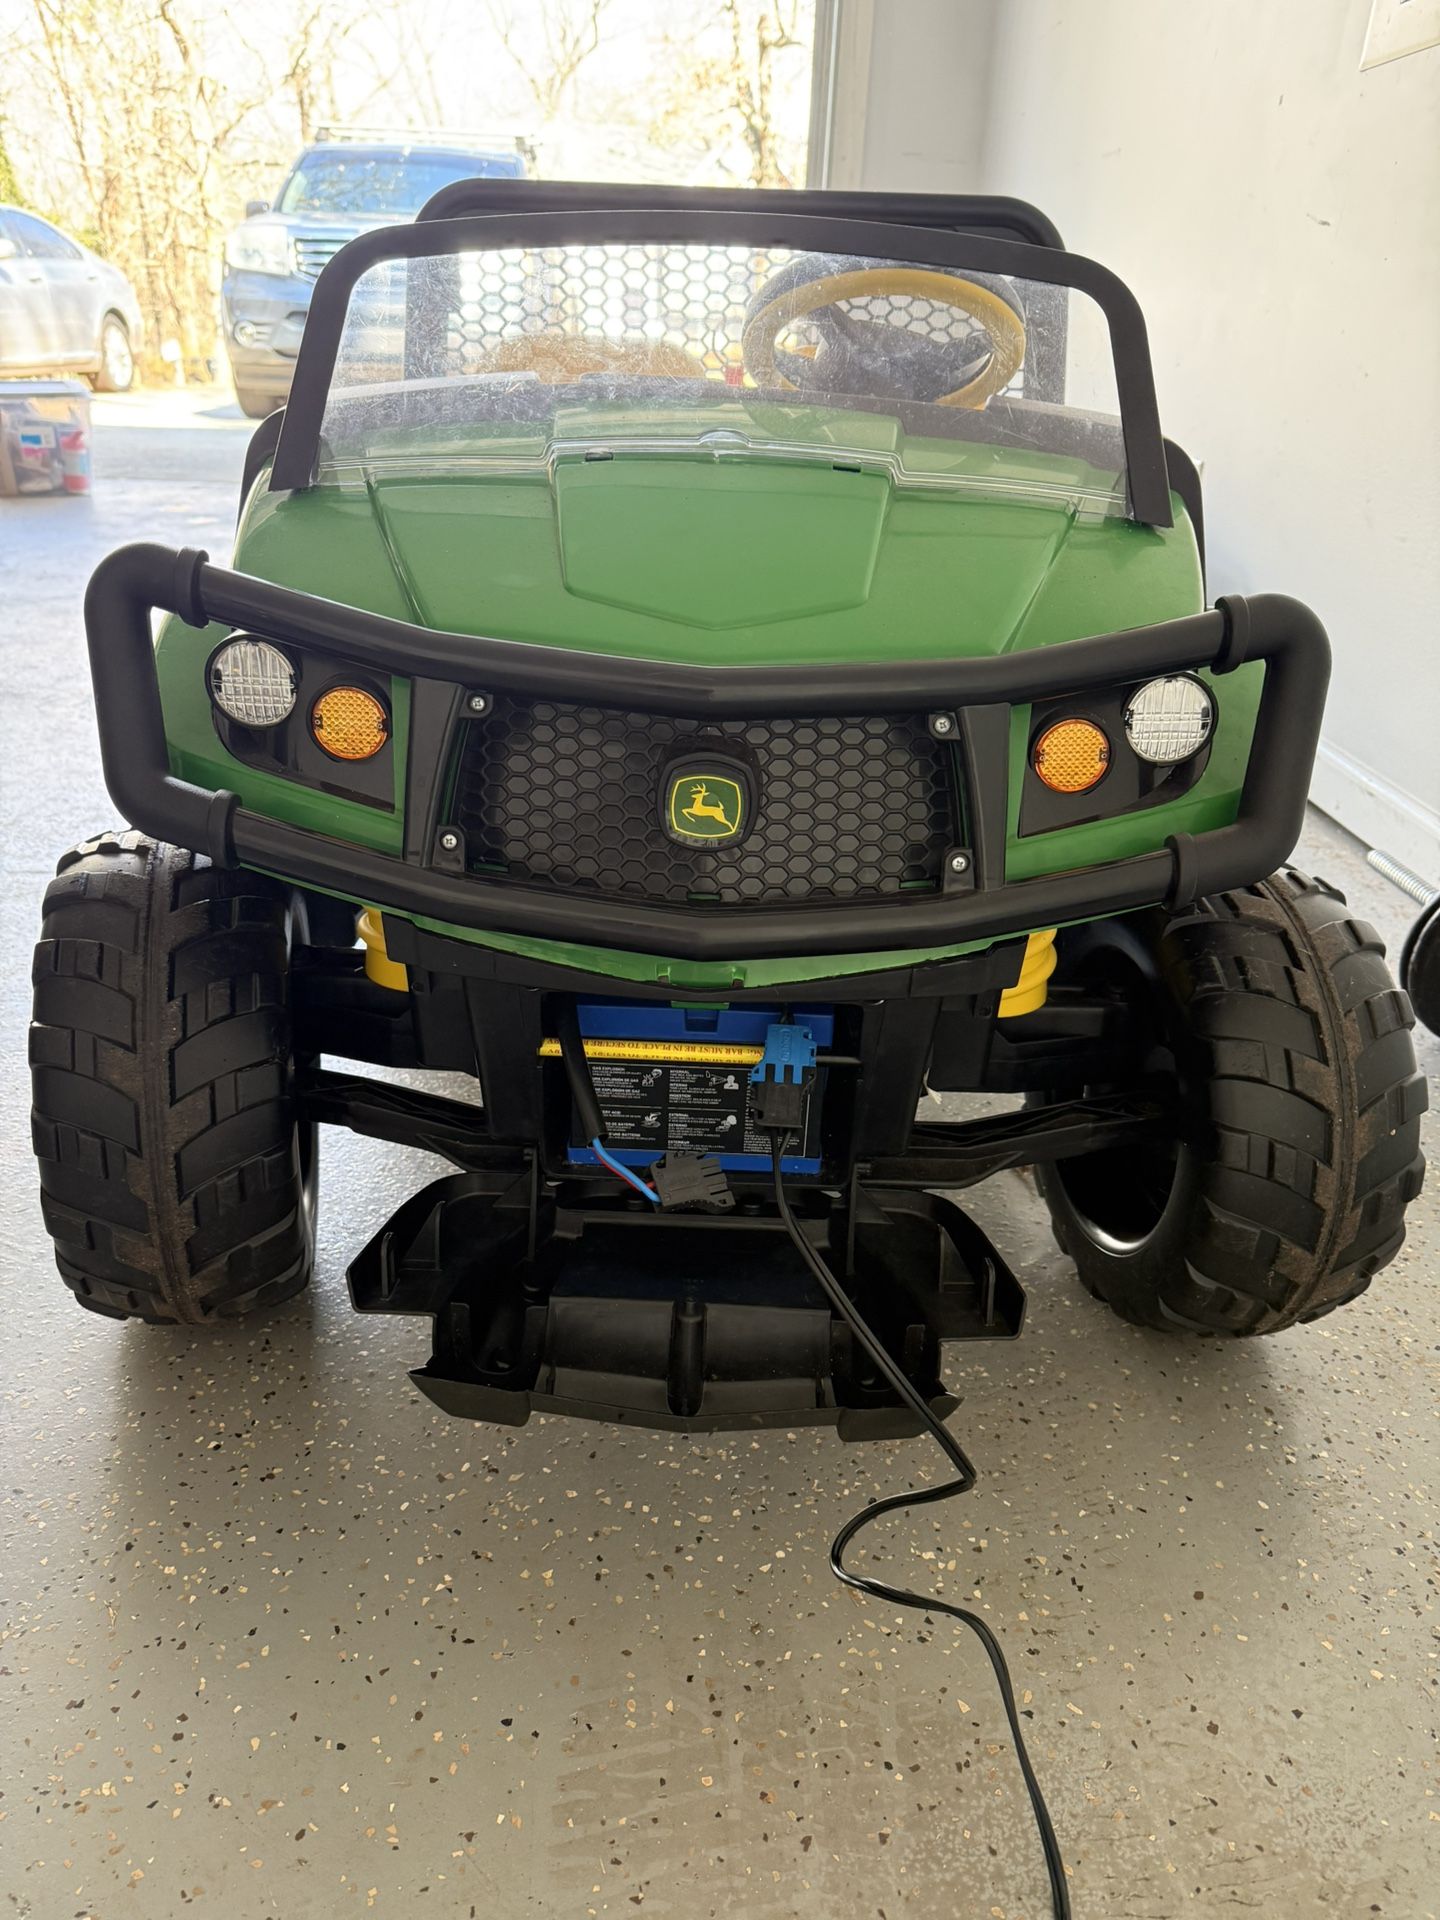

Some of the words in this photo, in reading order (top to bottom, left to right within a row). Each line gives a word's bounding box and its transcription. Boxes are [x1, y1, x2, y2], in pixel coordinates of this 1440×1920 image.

[590, 1039, 626, 1049] SECURE
[627, 1041, 640, 1049] TO
[642, 1041, 672, 1050] PLACE
[673, 1043, 683, 1051] IN
[684, 1044, 696, 1052] BE
[699, 1045, 723, 1054] MUST
[725, 1047, 743, 1055] BAR
